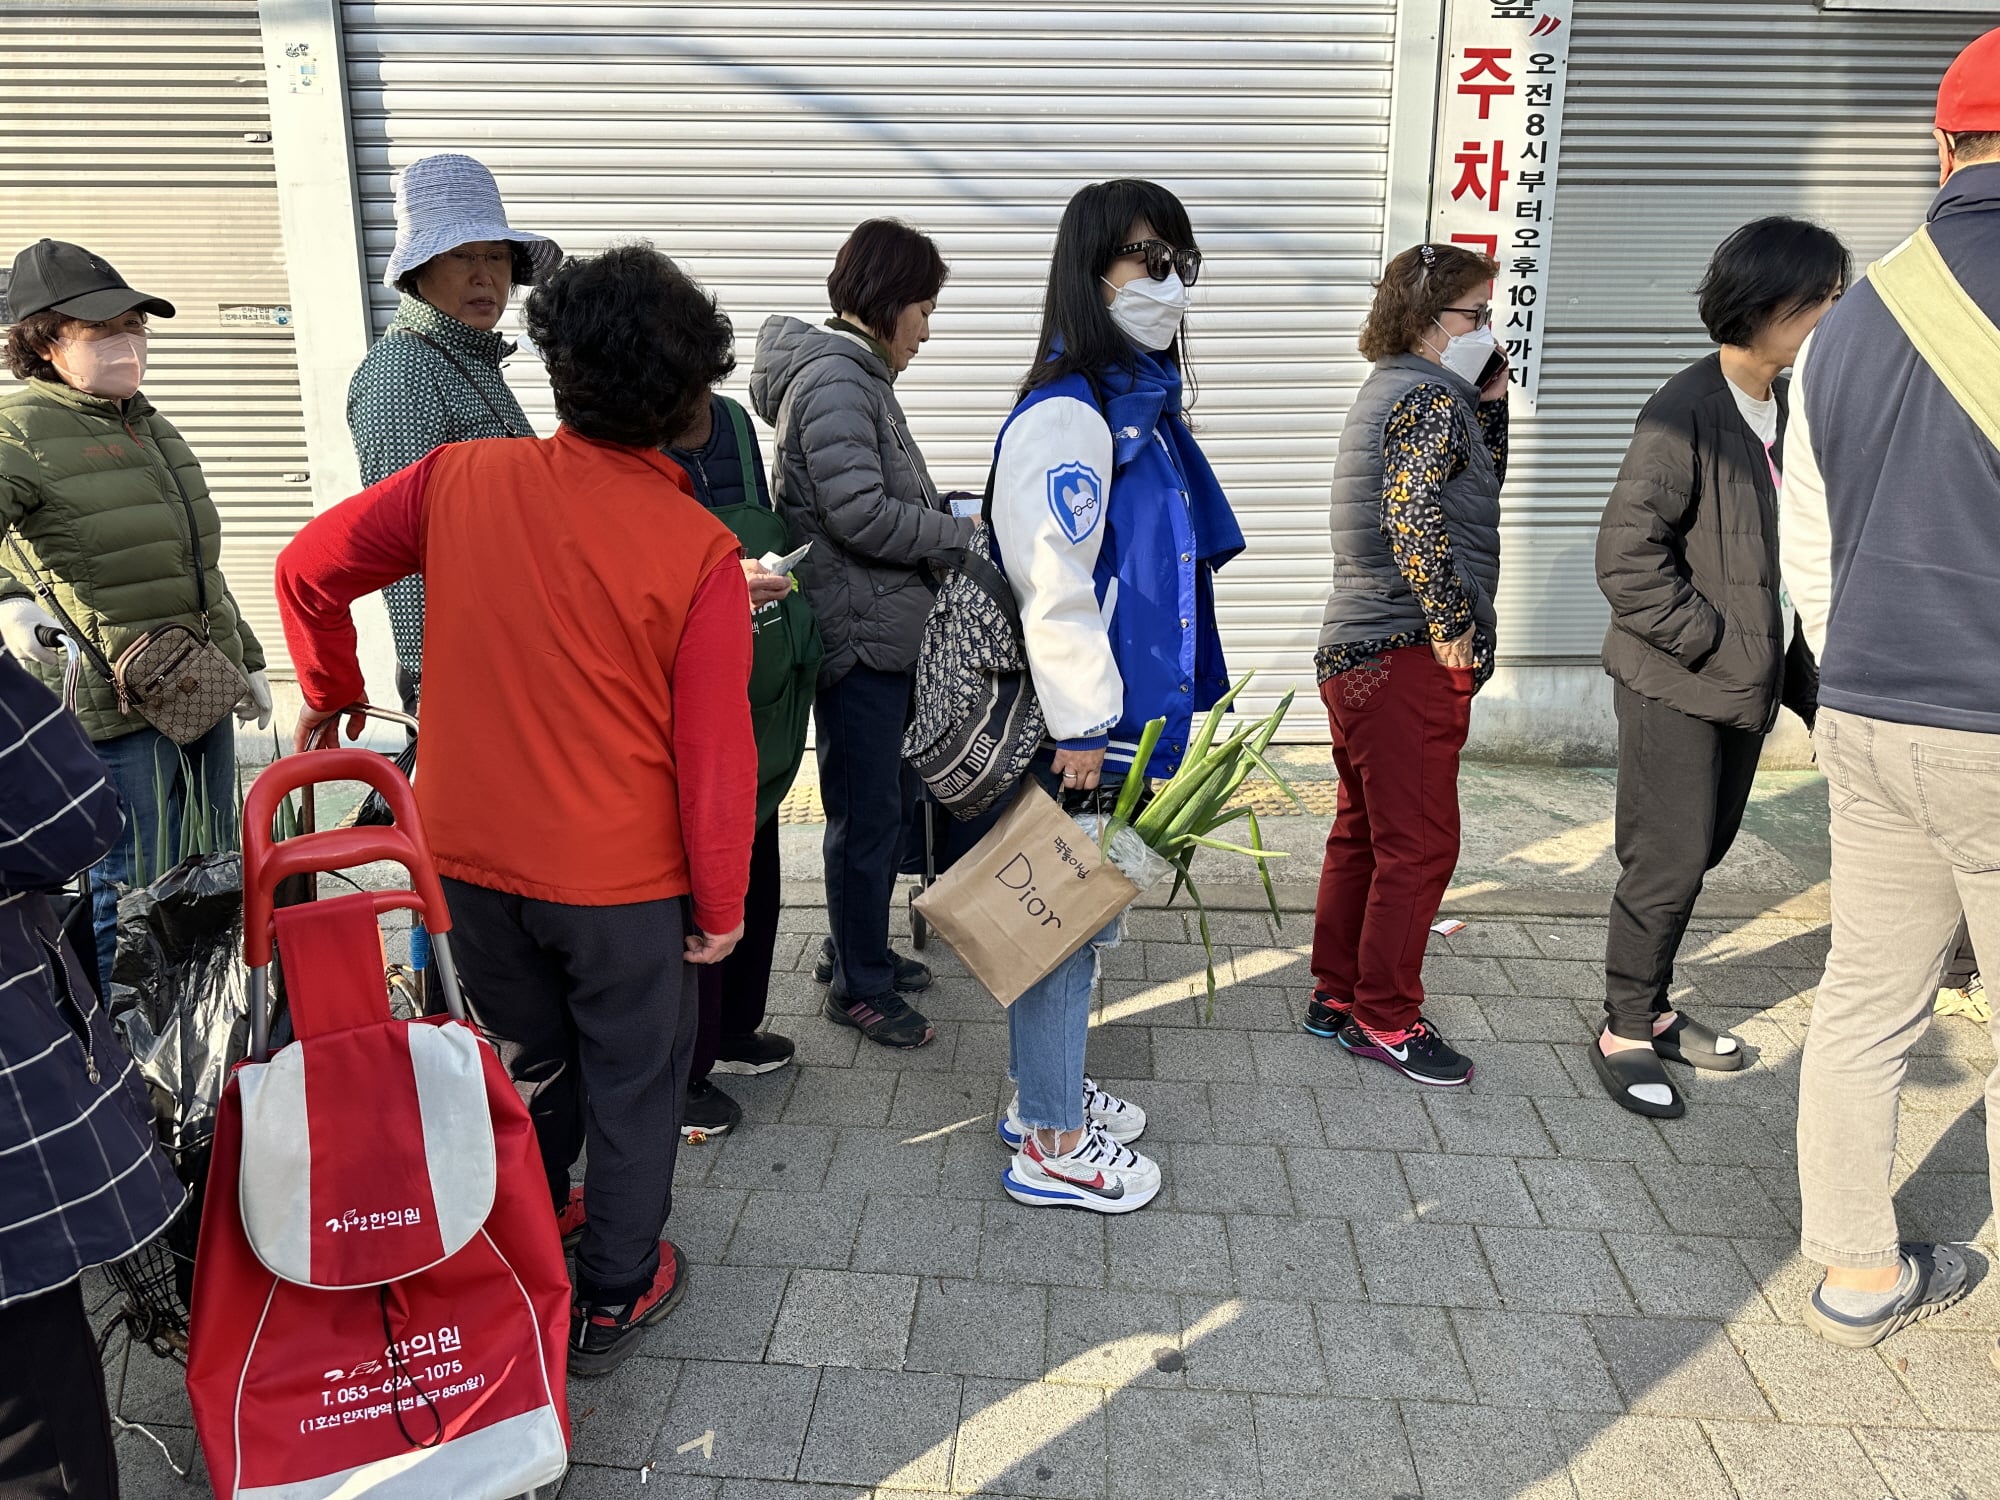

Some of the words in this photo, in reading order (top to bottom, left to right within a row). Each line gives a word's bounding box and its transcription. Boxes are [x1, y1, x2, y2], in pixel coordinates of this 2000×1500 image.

[964, 732, 998, 773] DIOR
[995, 852, 1062, 929] Dior
[321, 1390, 334, 1406] T.
